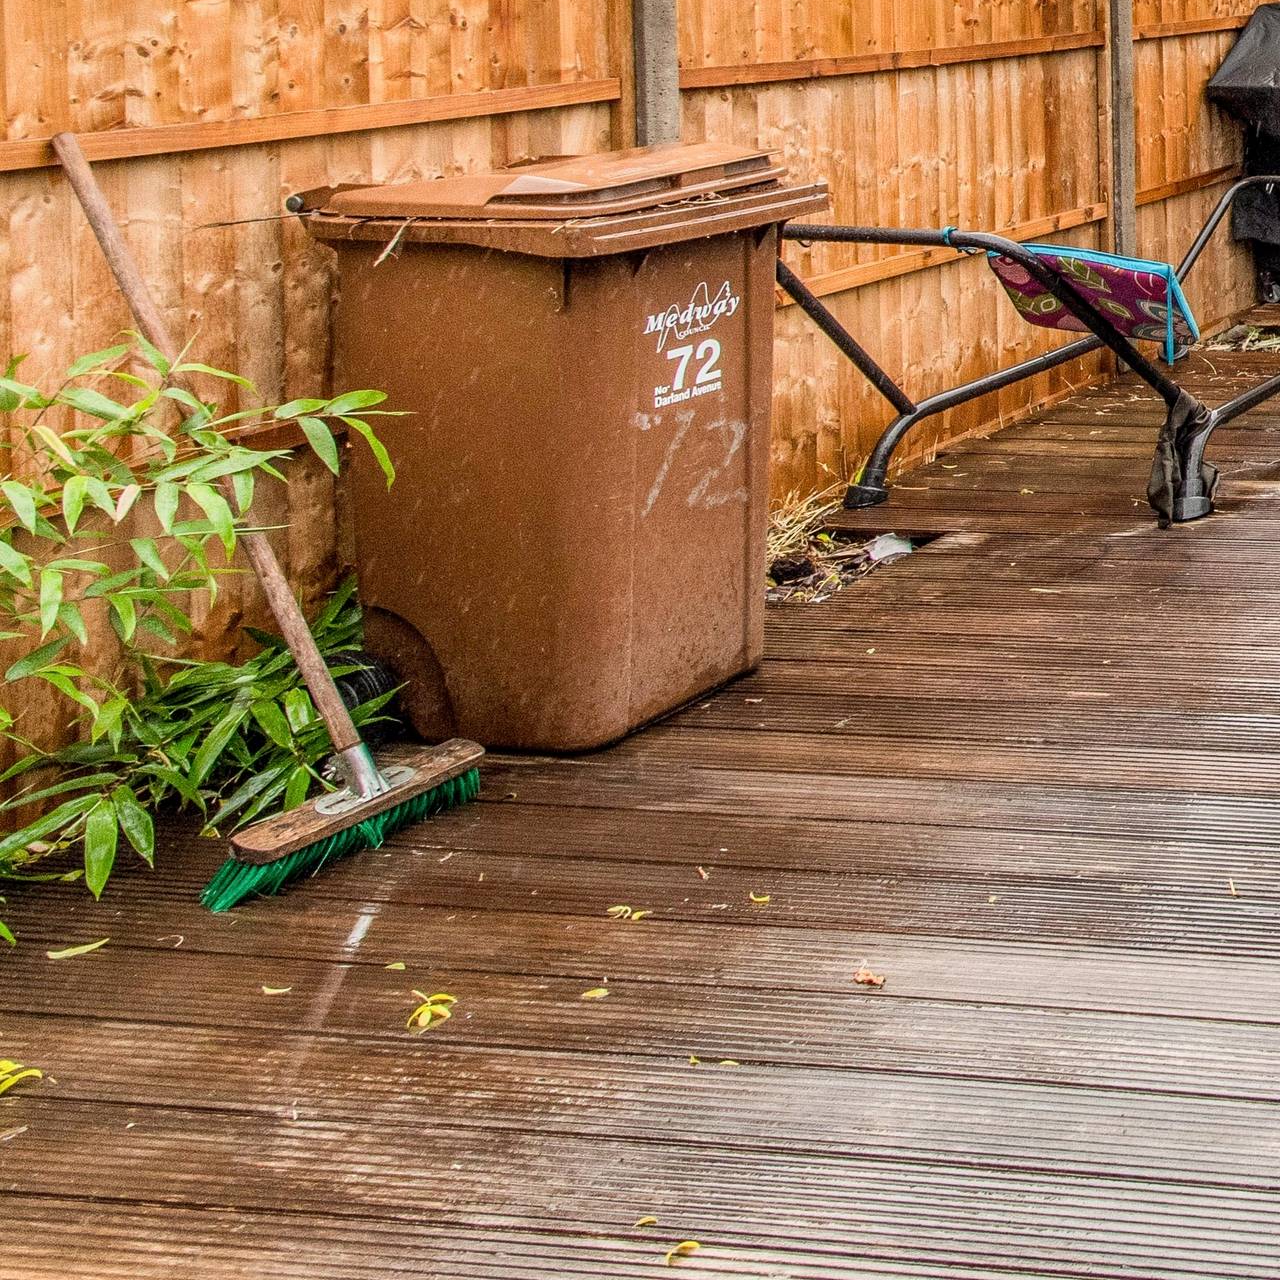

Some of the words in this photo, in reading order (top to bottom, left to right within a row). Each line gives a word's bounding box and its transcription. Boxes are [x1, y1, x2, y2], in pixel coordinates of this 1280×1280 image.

[642, 296, 740, 335] Medway
[667, 338, 722, 391] 72
[654, 387, 691, 408] Darland
[691, 381, 722, 398] Avenue
